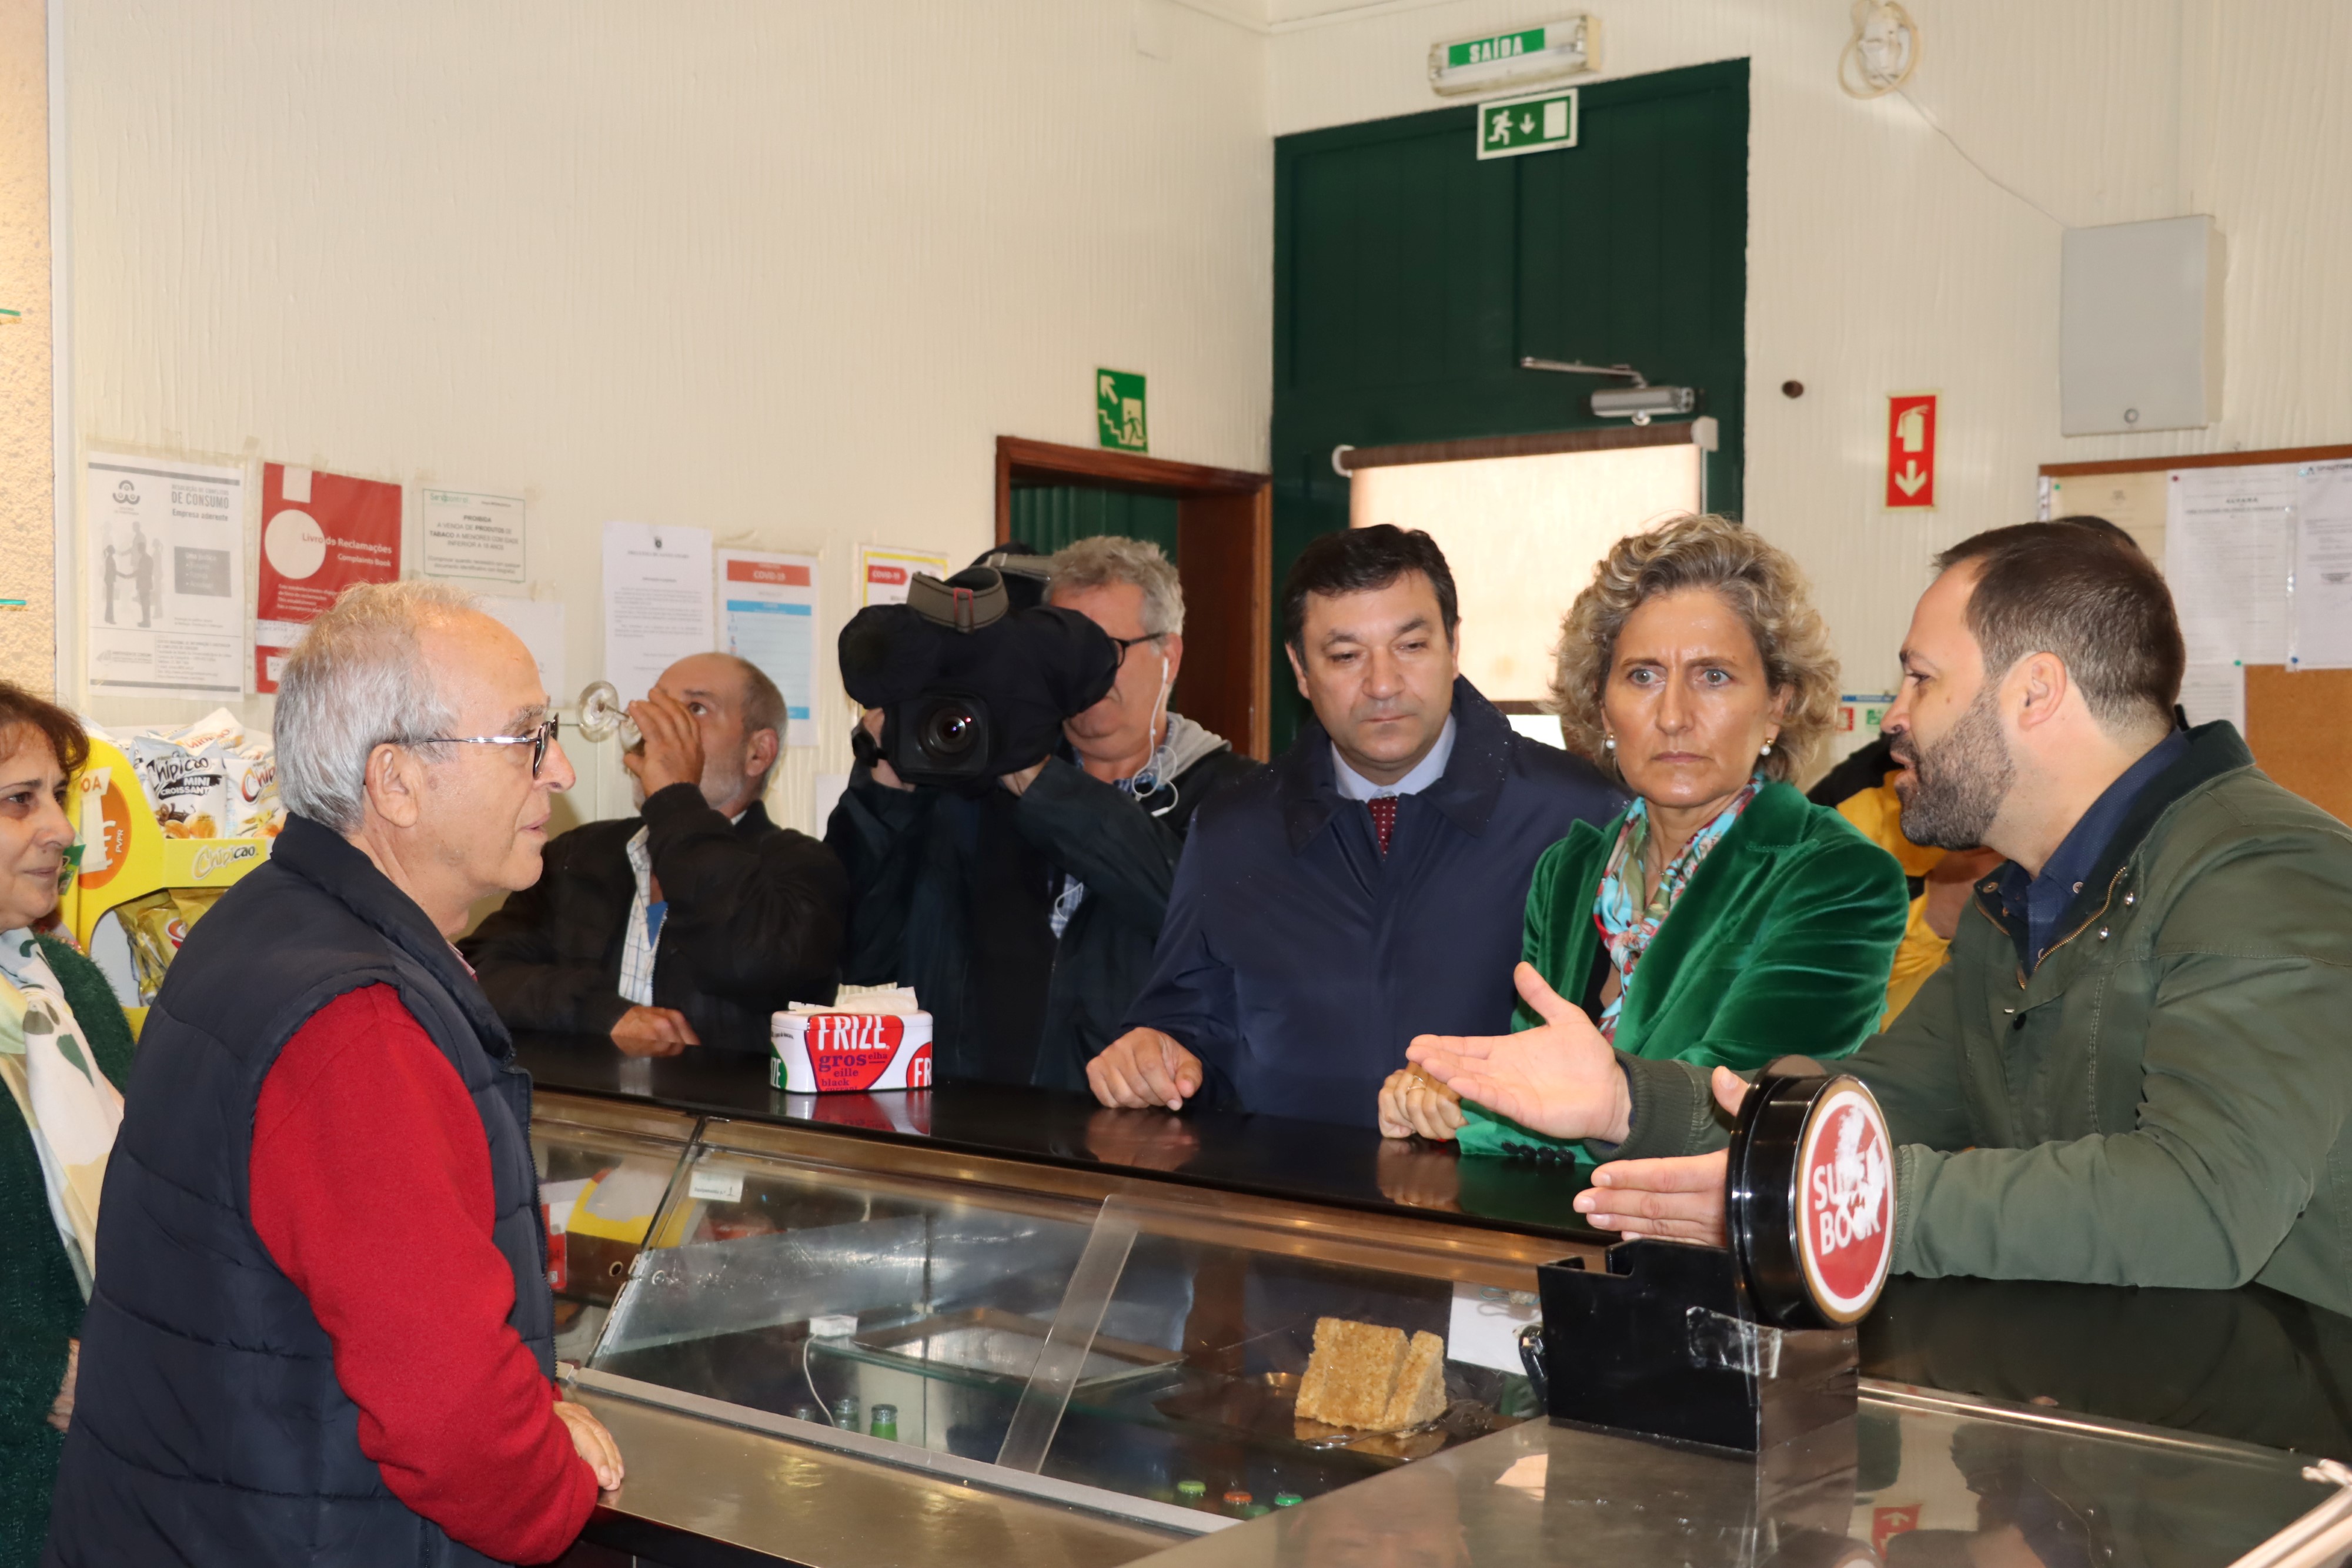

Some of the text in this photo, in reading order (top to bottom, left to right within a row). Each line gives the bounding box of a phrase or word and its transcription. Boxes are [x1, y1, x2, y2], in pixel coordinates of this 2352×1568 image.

[1469, 35, 1523, 63] SAÍDA
[171, 491, 229, 509] DE CONSUMO
[172, 509, 228, 521] Empresa aderente
[463, 514, 492, 523] PROIBIDA
[475, 525, 504, 534] PRODUTOS
[302, 532, 393, 554] Livro de Reclamações
[462, 533, 490, 541] MENORES
[447, 540, 476, 548] INFERIOR
[337, 553, 392, 567] Complaints Book
[753, 570, 786, 581] COVID-19
[871, 570, 901, 580] COVID-19
[183, 777, 210, 786] MINI
[115, 829, 123, 853] PVPR
[193, 845, 255, 879] Chipicao
[818, 1015, 887, 1051] FRIZE
[818, 1053, 867, 1072] gros
[834, 1068, 858, 1077] eille
[821, 1078, 850, 1086] black
[1813, 1149, 1883, 1210] SUE
